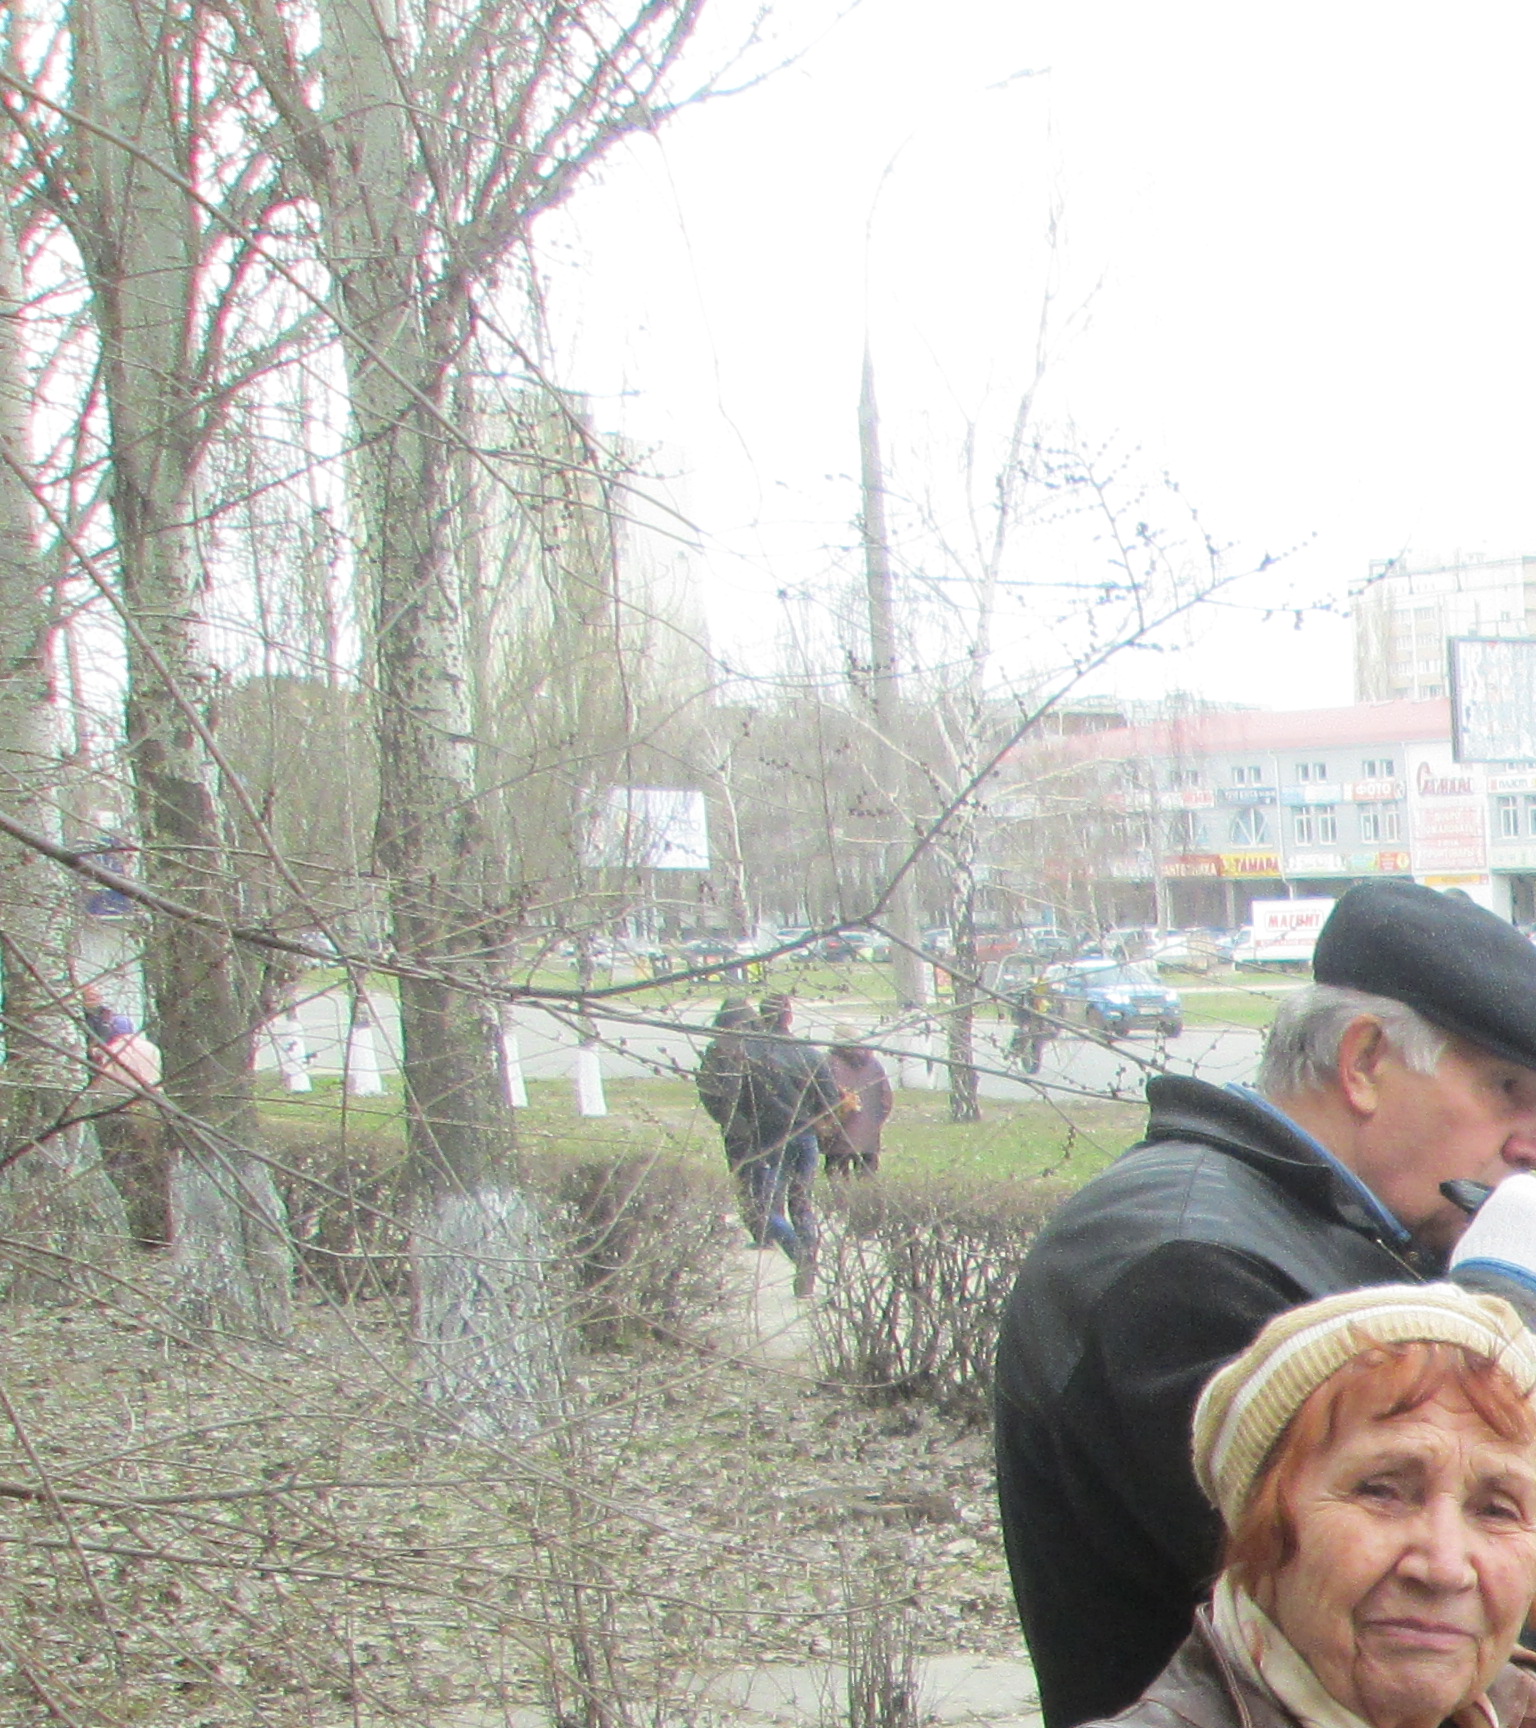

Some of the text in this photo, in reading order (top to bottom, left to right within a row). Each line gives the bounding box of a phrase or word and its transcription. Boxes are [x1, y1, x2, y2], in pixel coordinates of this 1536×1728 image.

[1356, 782, 1391, 794] ФОТО
[1234, 856, 1281, 873] ТАМАРА
[1268, 913, 1321, 928] МАГНИТ
